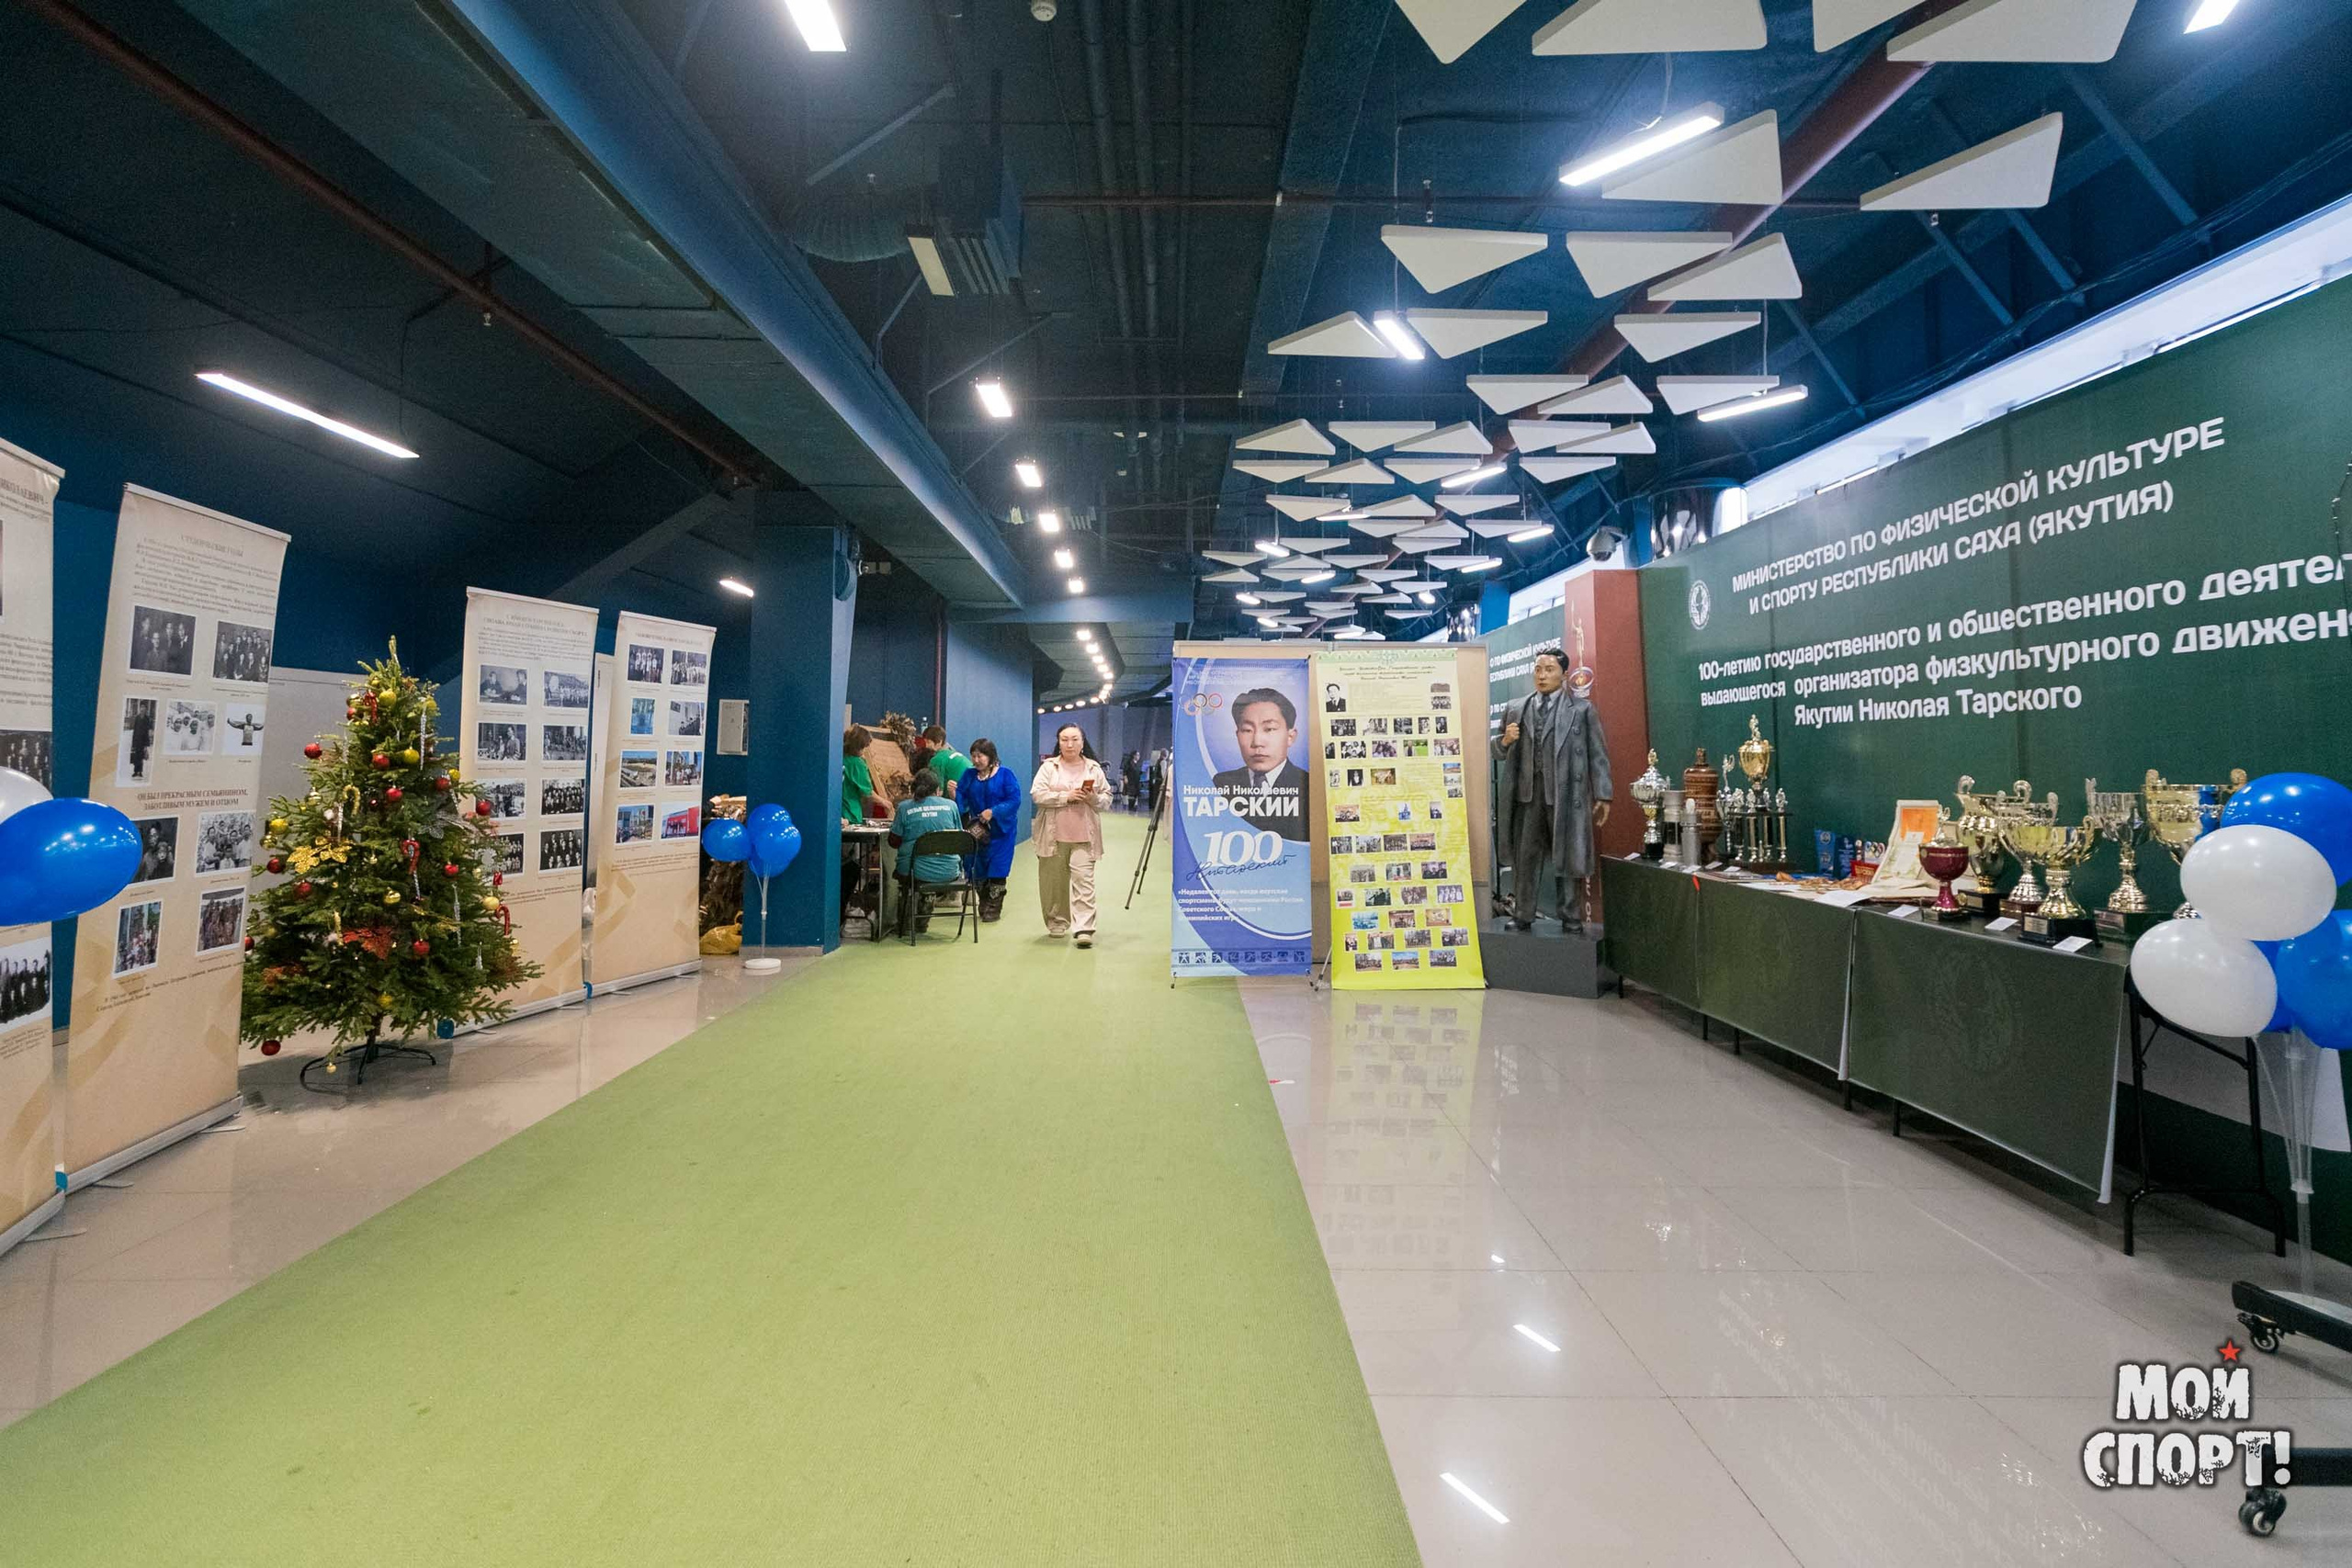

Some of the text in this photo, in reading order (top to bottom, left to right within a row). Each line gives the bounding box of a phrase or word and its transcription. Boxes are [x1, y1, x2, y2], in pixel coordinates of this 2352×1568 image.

[1732, 416, 2225, 592] МИНИСТЕРСТВО ПО ФИЗИЧЕСКОЙ КУЛЬТУРЕ
[1748, 479, 2174, 615] И СПОРТУ РЕСПУБЛИКИ САХА (ЯКУТИЯ)
[1698, 655, 1761, 681] 100-летию
[1764, 626, 1921, 671] государственного
[1928, 622, 1941, 643] и
[1948, 580, 2187, 639] общественного
[1701, 608, 2352, 707] выдающегося организатора физкультурного движен
[1794, 685, 2082, 728] Якутии Николая Тарского
[1183, 784, 1299, 795] Николай Николаевич
[1204, 830, 1283, 867] 100
